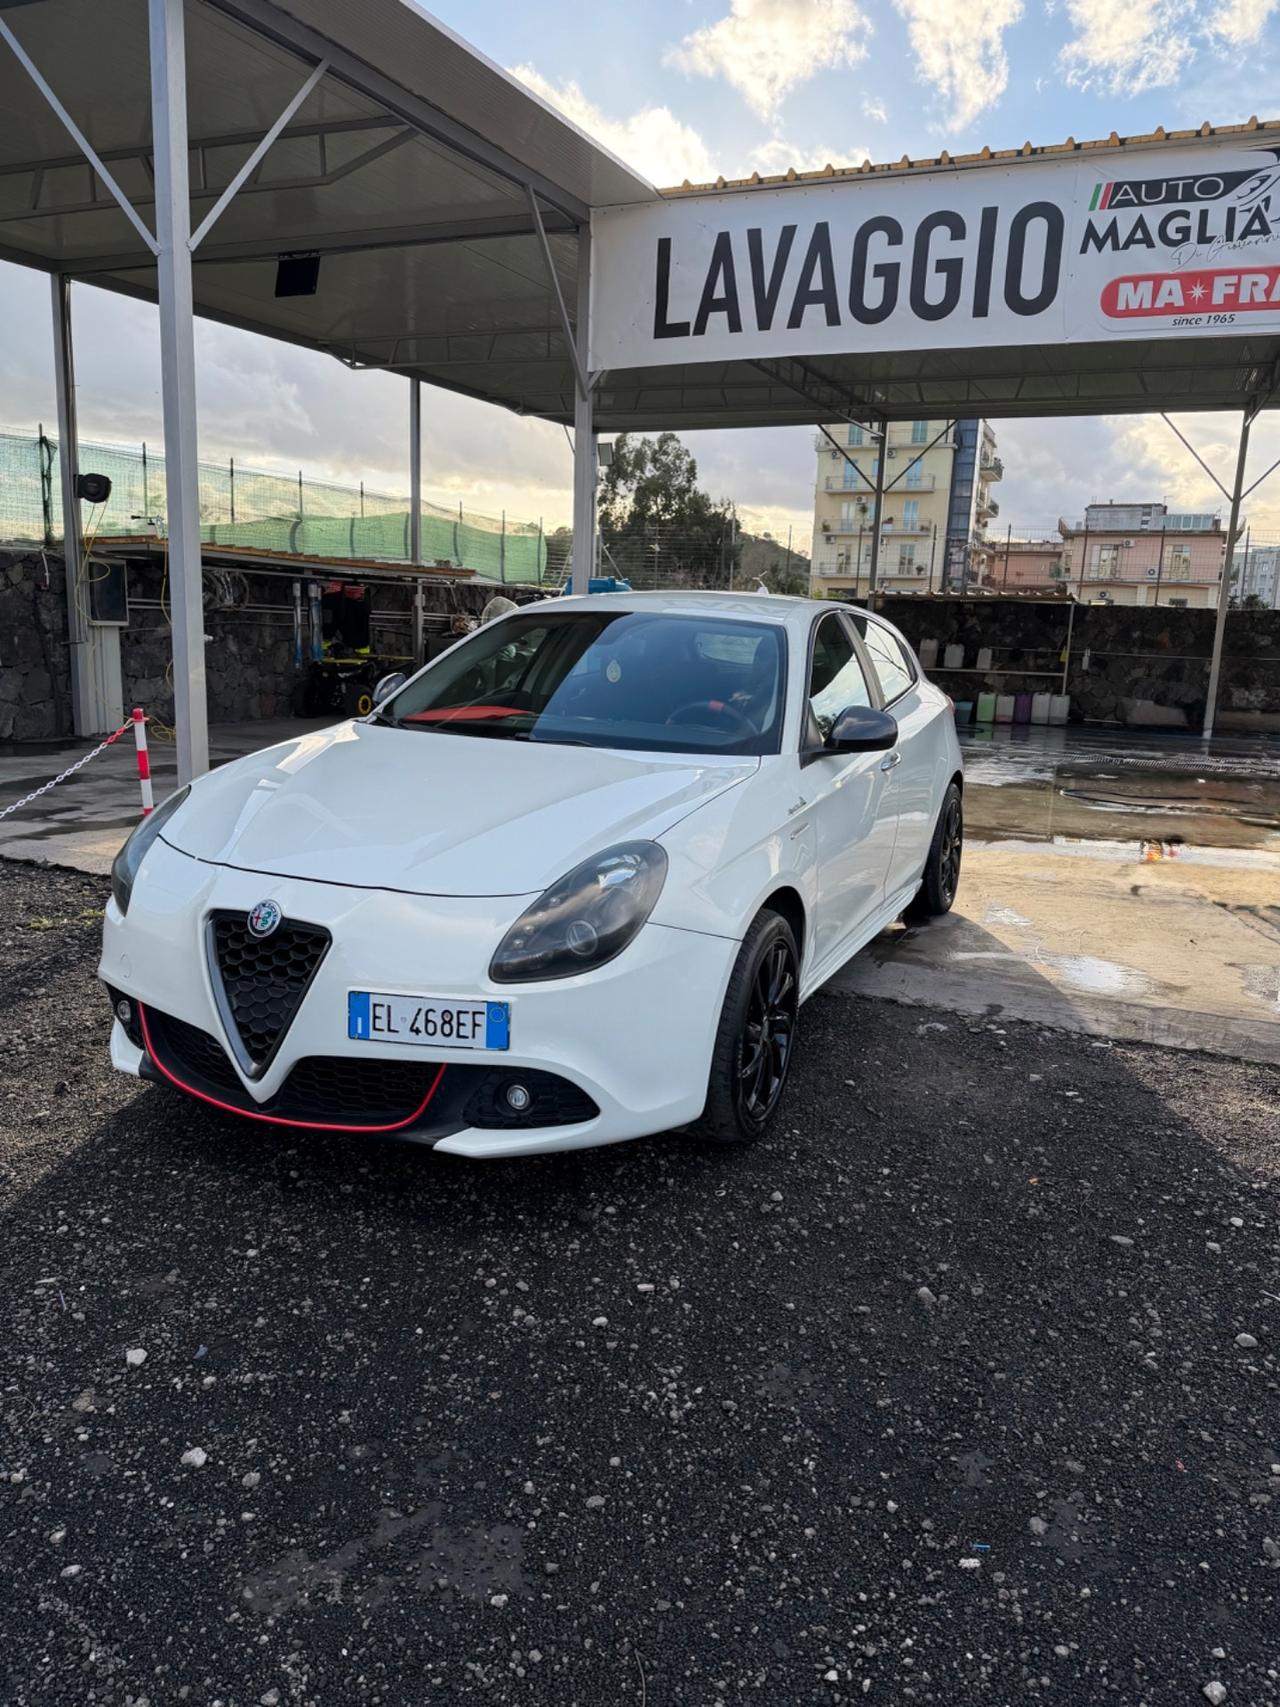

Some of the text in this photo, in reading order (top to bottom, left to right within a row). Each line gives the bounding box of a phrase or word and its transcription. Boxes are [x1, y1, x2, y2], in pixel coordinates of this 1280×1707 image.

[1111, 177, 1225, 207] AUTO
[1079, 203, 1272, 254] MAGLIA
[653, 200, 1065, 340] LAVAGGIO
[1116, 279, 1185, 311] MA
[1172, 313, 1236, 326] since 1965
[372, 1003, 485, 1039] EL 468EF
